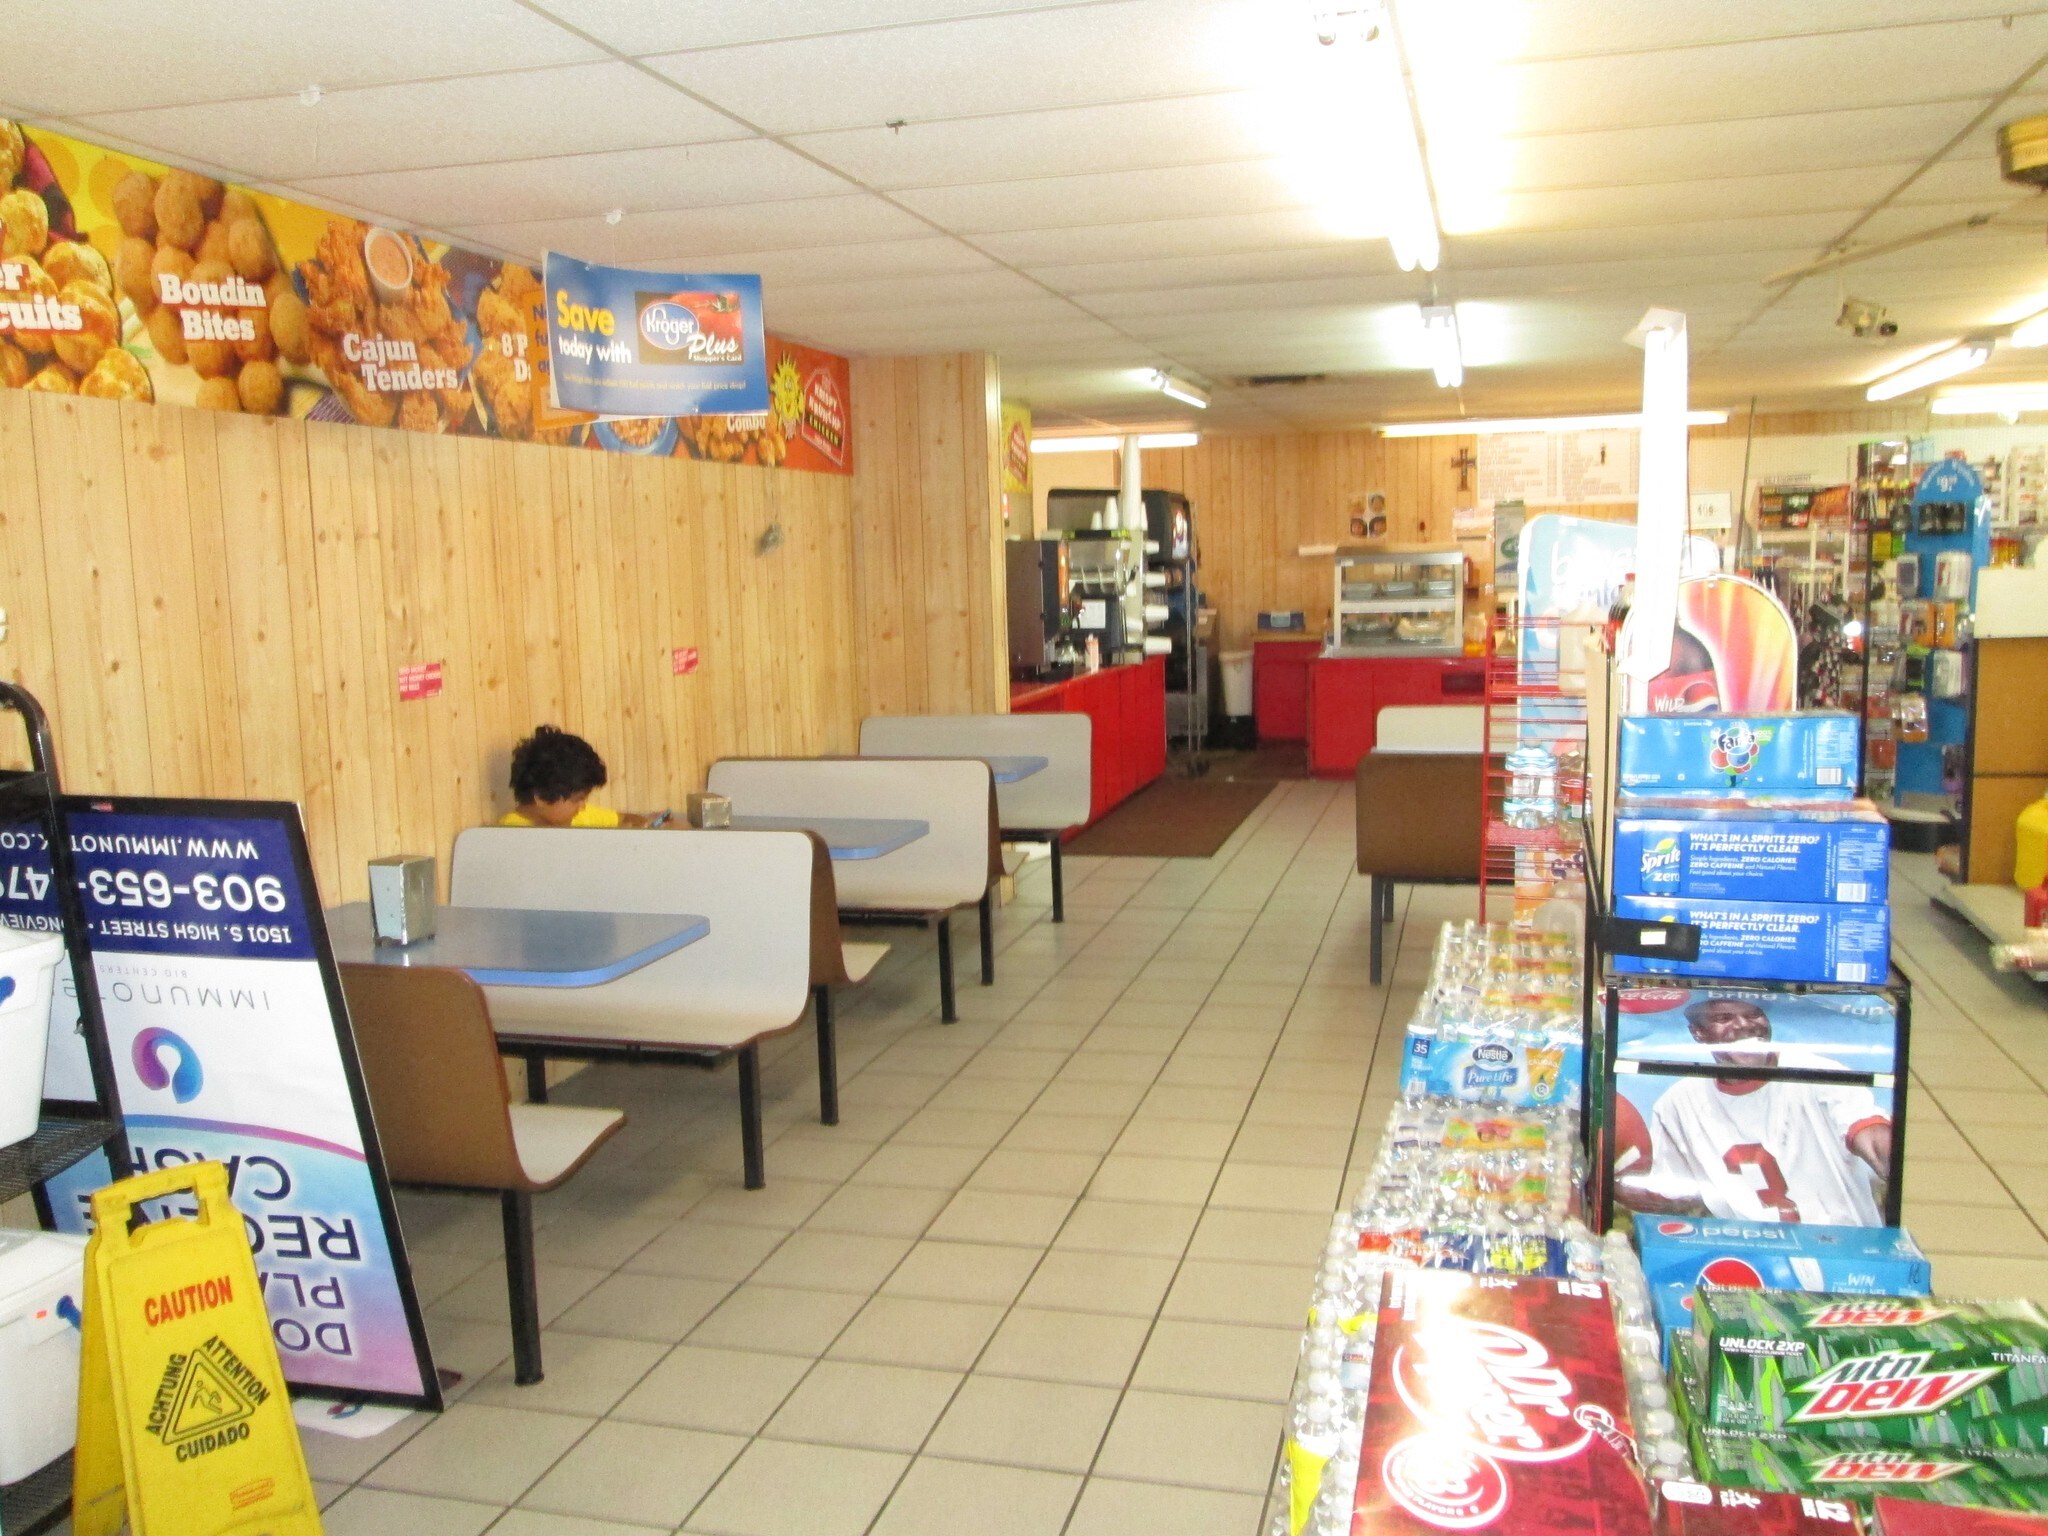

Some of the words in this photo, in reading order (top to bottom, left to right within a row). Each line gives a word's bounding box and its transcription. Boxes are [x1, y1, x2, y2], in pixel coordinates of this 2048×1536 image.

[158, 274, 266, 307] Boudin
[556, 289, 615, 336] Save
[180, 309, 256, 341] Bites
[645, 307, 694, 345] Kroger
[343, 333, 418, 368] Cajun
[502, 332, 513, 357] 8
[558, 334, 594, 365] today
[597, 340, 632, 364] with
[687, 333, 739, 360] Plus
[361, 364, 458, 392] Tenders
[1690, 833, 1728, 842] WHAT'S
[1730, 834, 1739, 842] IN
[1741, 834, 1749, 843] A
[1751, 834, 1785, 844] SPRITE
[1787, 835, 1820, 845] ZERO?
[1690, 843, 1708, 851] IT'S
[1709, 843, 1765, 852] PERFECTLY
[1767, 845, 1800, 853] CLEAR.
[1641, 849, 1680, 872] Sprite
[1690, 911, 1727, 920] WHAT'S
[1729, 912, 1739, 920] IN
[1741, 912, 1749, 921] A
[1751, 913, 1785, 922] SPRITE
[1787, 914, 1820, 924] ZERO?
[1709, 921, 1765, 931] PERFECTLY
[1766, 923, 1800, 932] CLEAR.
[100, 920, 169, 939] STREET
[175, 923, 221, 941] HIGH
[224, 924, 243, 942] S.
[250, 925, 292, 944] 1501
[1413, 1042, 1428, 1055] 35
[1468, 1072, 1491, 1084] Pure
[1493, 1071, 1513, 1083] Life
[1702, 1226, 1786, 1240] pepsi
[1848, 1273, 1876, 1287] WIN
[144, 1275, 234, 1327] CAUTION
[1719, 1337, 1775, 1351] UNLOCK
[1776, 1341, 1805, 1352] 2XP
[202, 1335, 271, 1406] ATTENTION
[145, 1353, 188, 1437] ACHTUNG
[175, 1422, 251, 1463] CUIDADO
